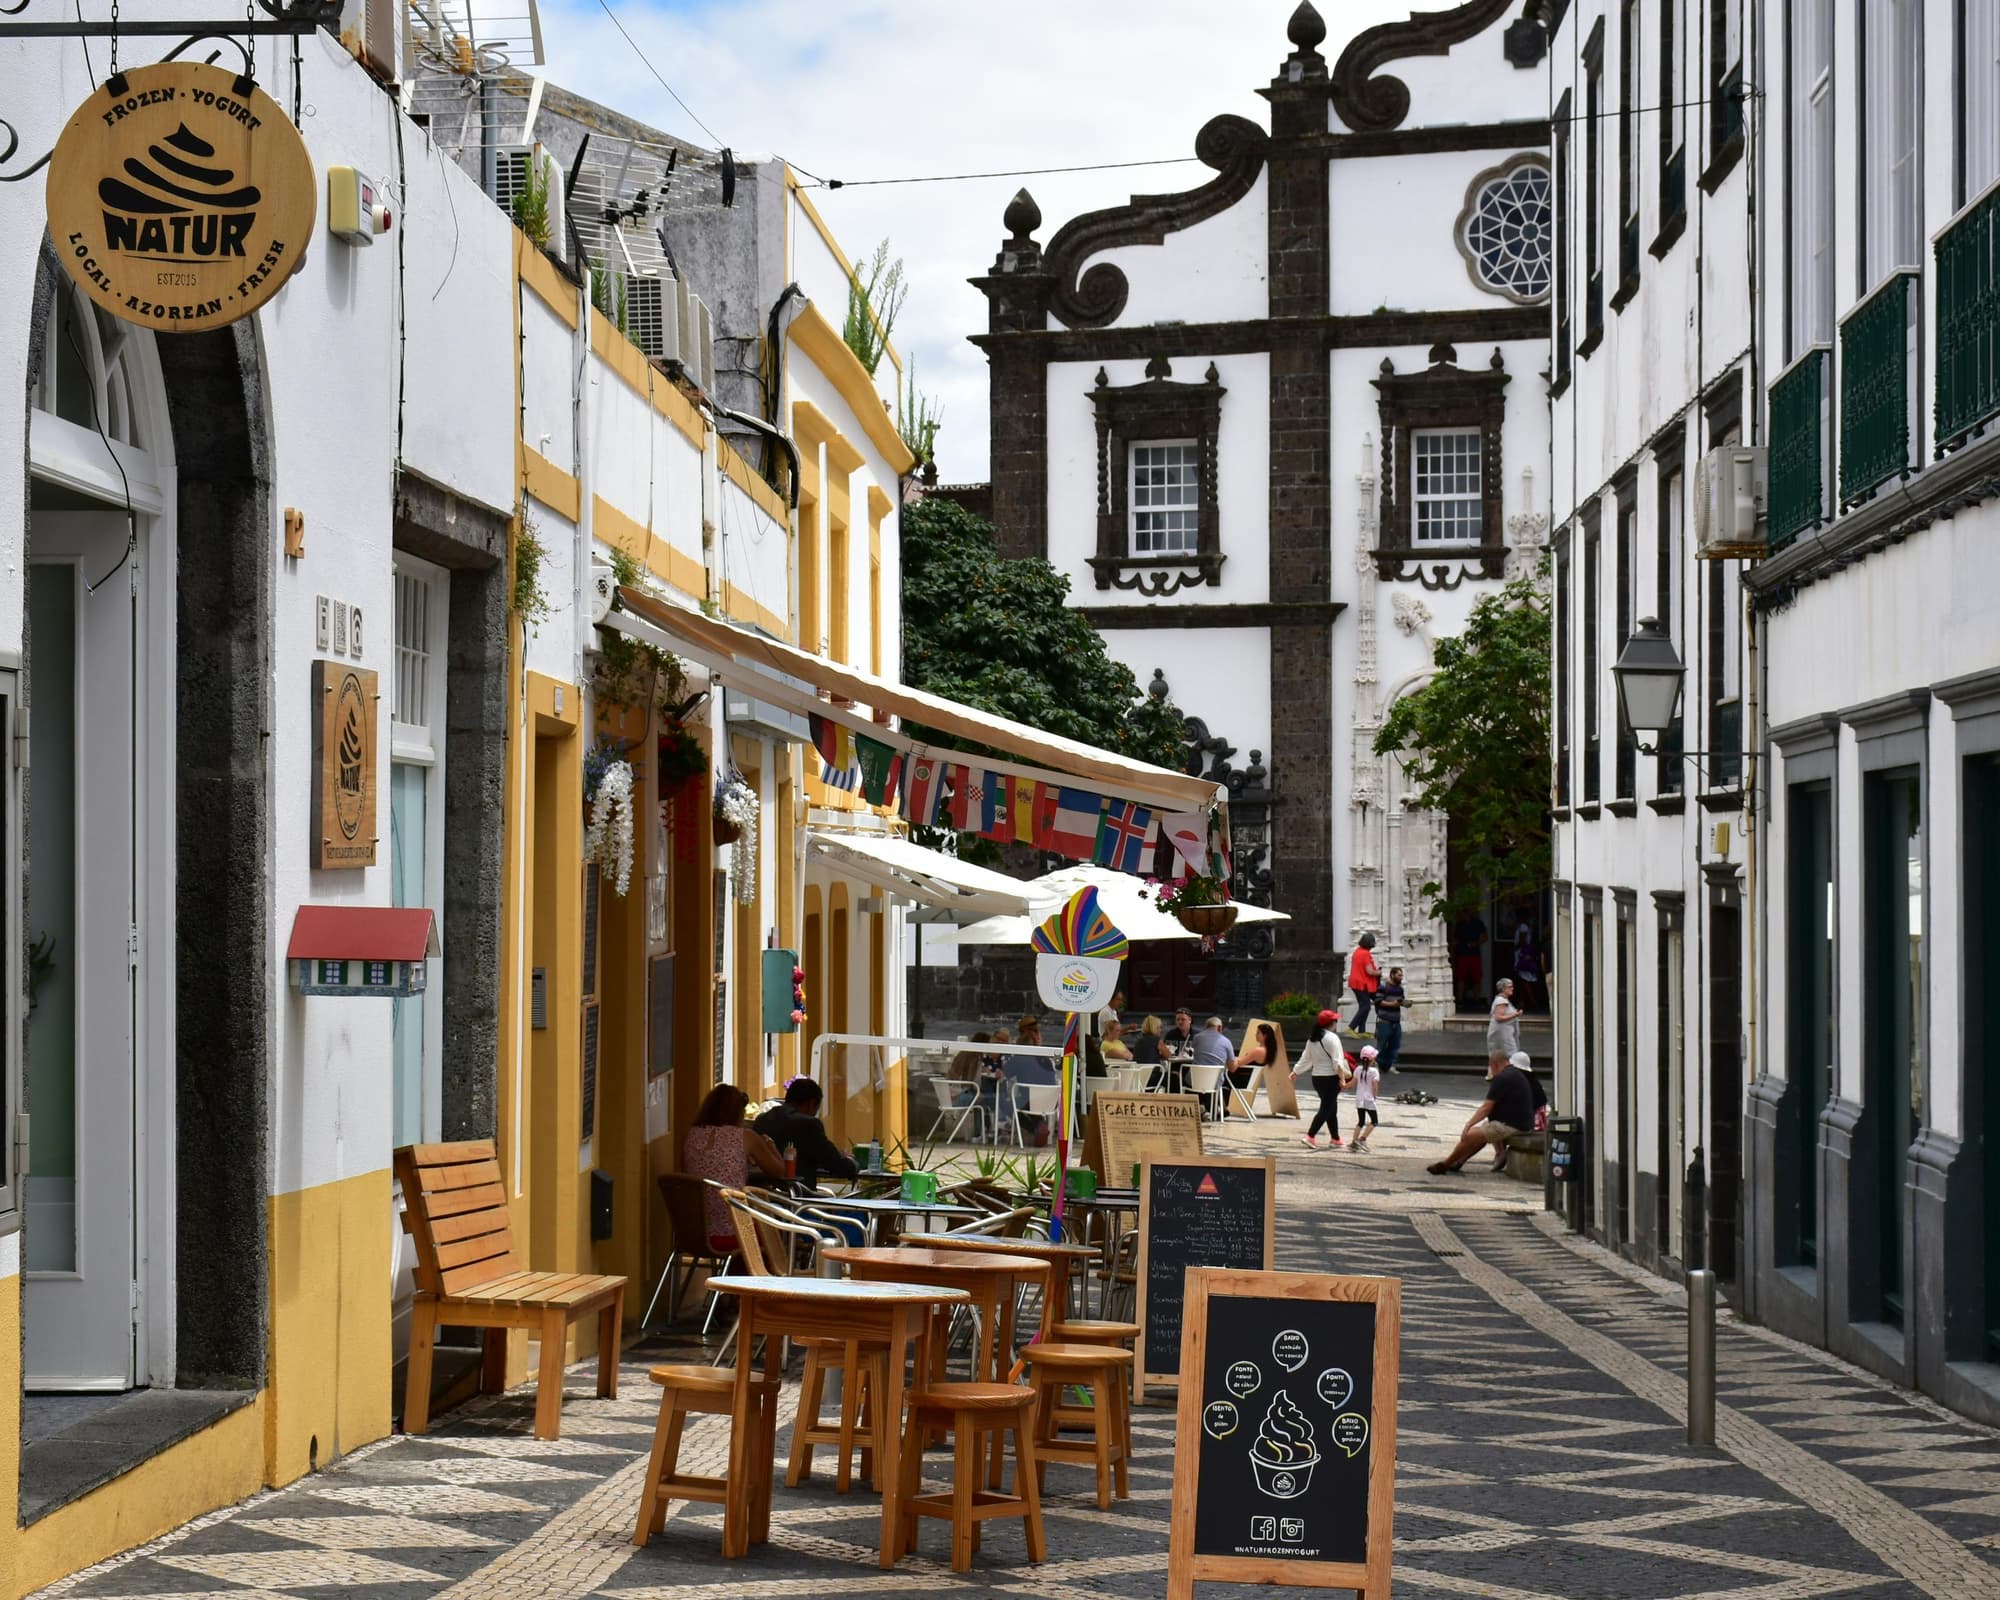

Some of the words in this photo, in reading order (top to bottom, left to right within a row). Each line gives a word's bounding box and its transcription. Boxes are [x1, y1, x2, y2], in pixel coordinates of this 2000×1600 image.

[102, 87, 176, 128] FROZEN
[192, 88, 262, 131] YOGURT
[102, 209, 257, 257] NATUR
[69, 232, 112, 293] LOCAL
[125, 292, 223, 320] AZOREAN
[237, 239, 286, 298] FRESH
[1062, 983, 1090, 994] NATUR
[1140, 1104, 1195, 1119] CENTRAL
[1234, 1546, 1321, 1557] #NATURFROZENYOGURT
